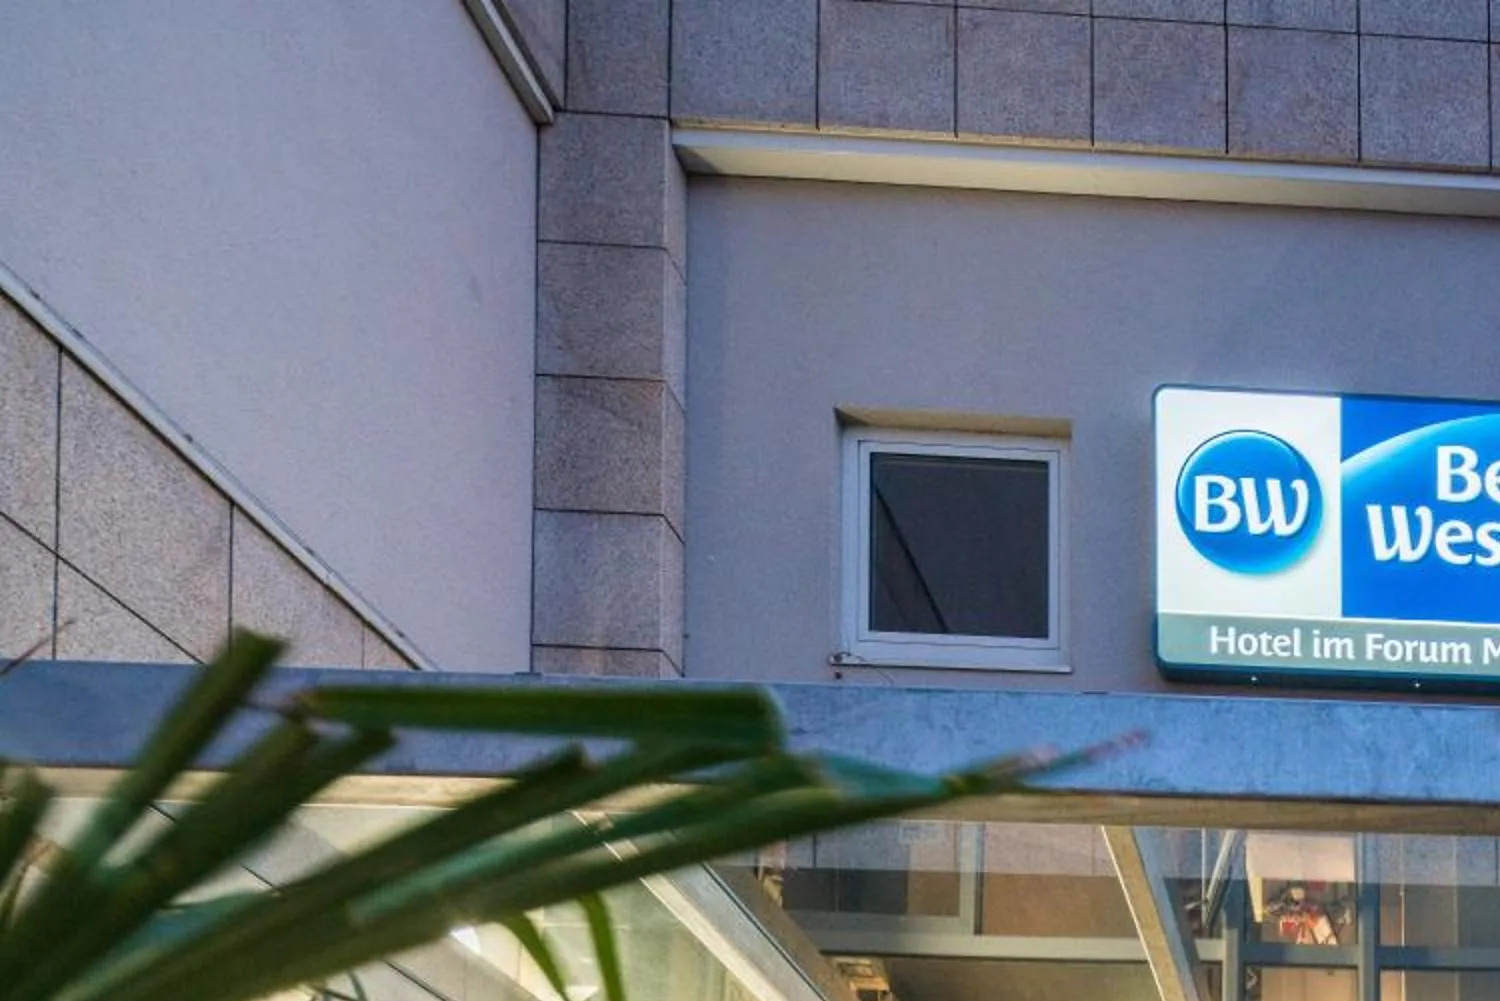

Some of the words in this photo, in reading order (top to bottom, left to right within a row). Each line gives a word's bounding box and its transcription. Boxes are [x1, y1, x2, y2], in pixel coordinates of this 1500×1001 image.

[1194, 474, 1308, 536] BW
[1209, 625, 1301, 657] Hotel
[1312, 630, 1354, 661] im
[1365, 633, 1471, 665] Forum
